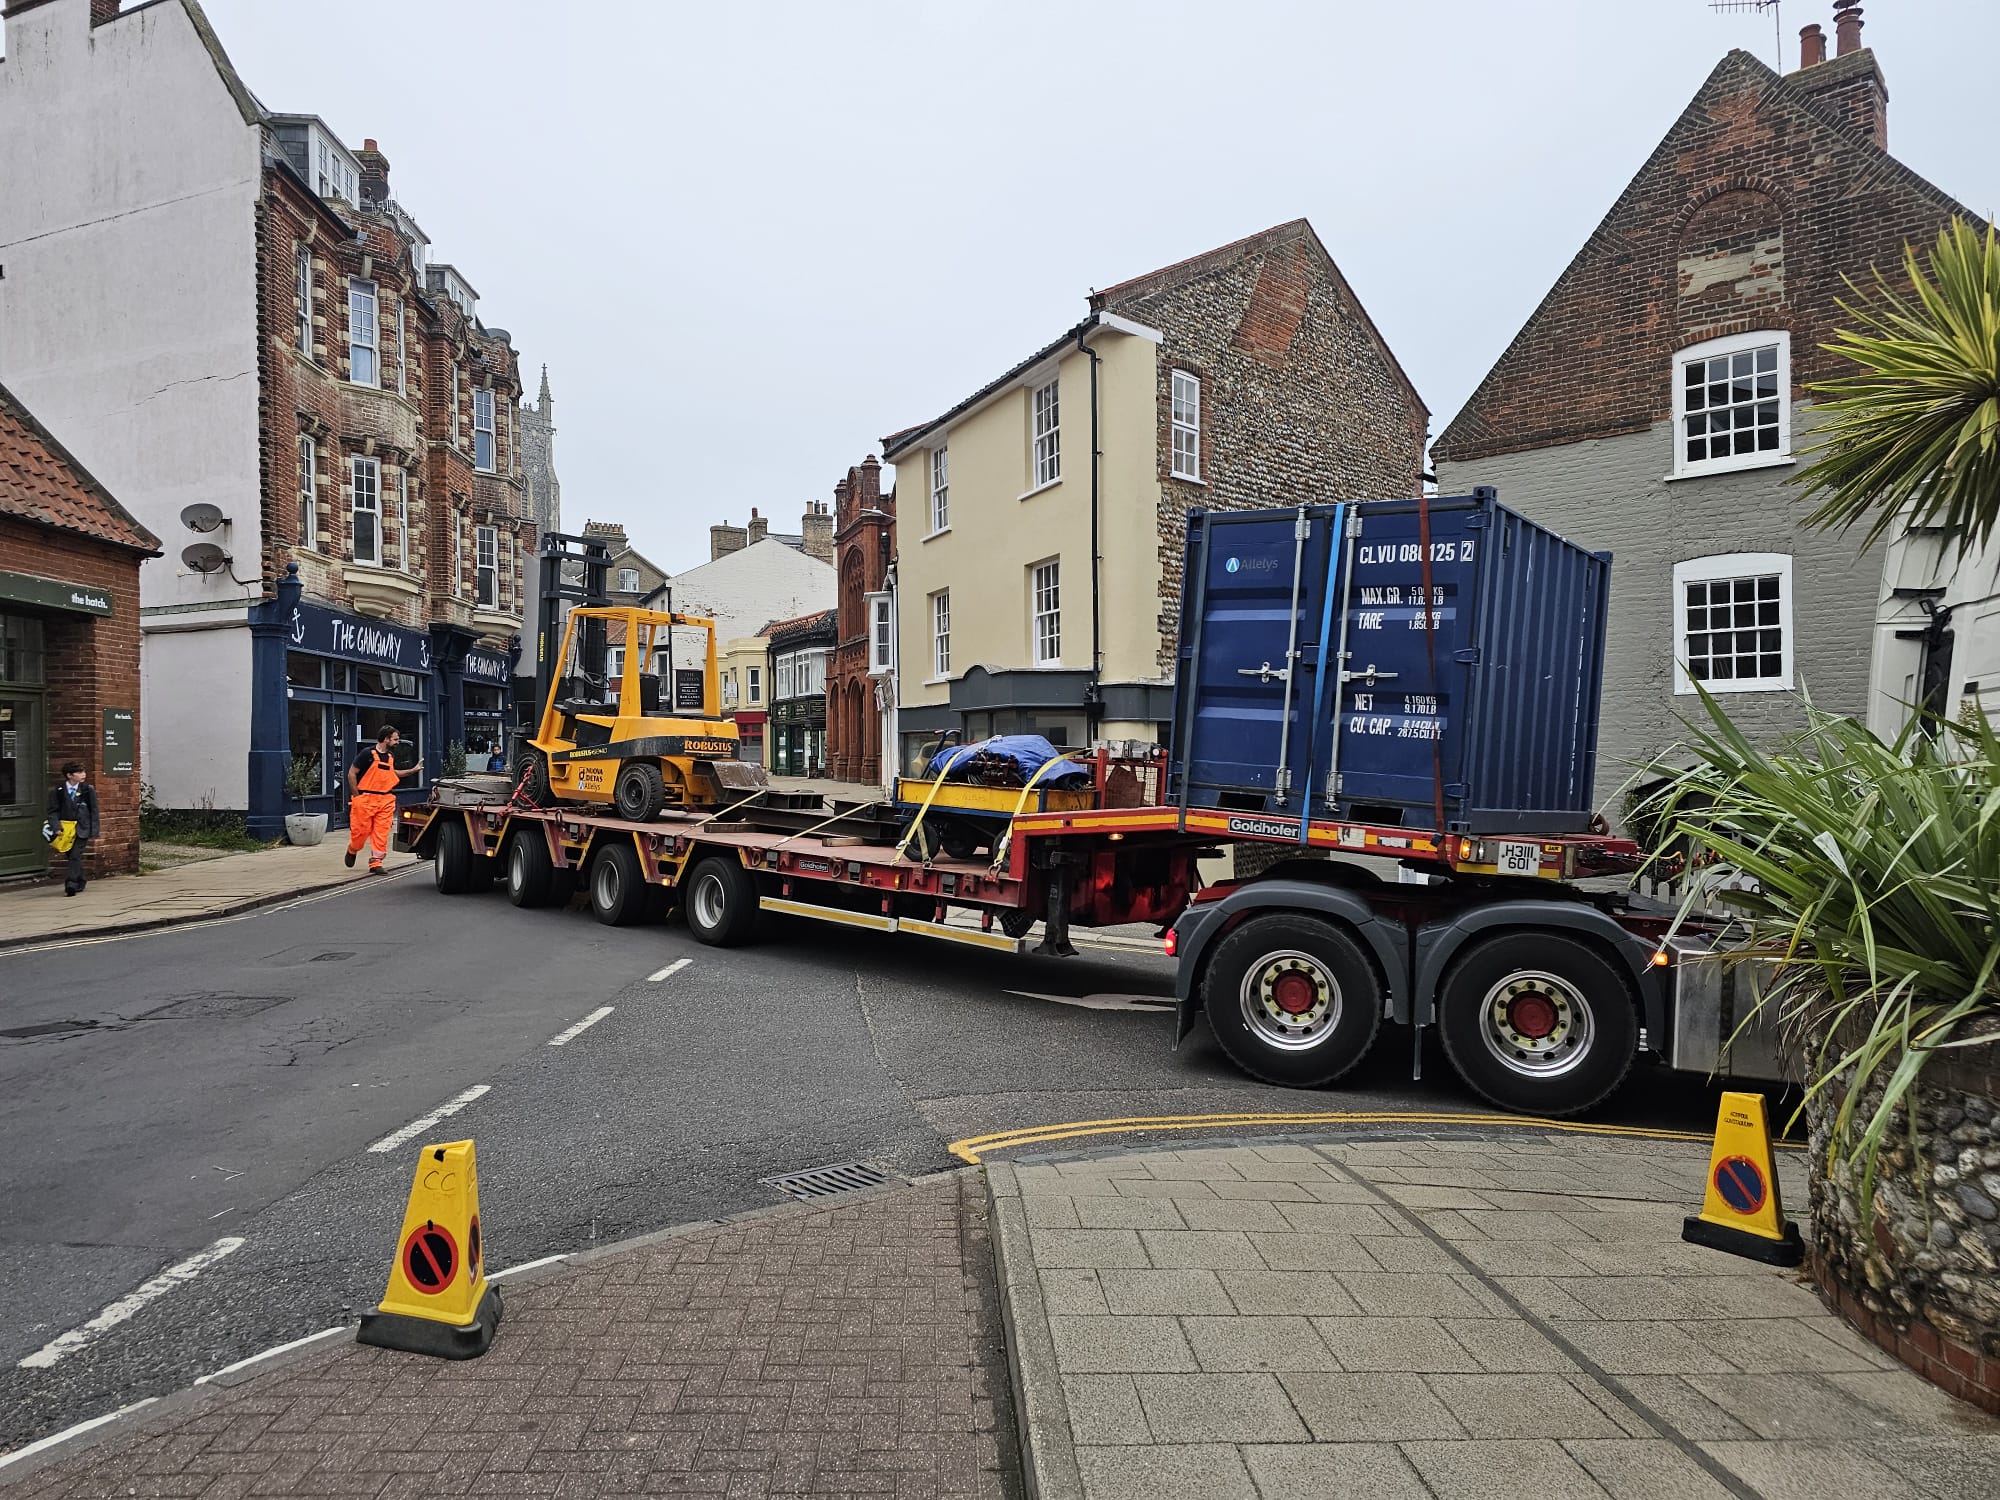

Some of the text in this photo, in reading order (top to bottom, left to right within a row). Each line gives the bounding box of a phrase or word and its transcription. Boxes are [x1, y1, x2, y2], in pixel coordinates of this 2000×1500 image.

[1359, 545, 1396, 564] CLVU
[1461, 541, 1474, 561] 2
[1240, 558, 1279, 572] Allelys
[71, 592, 108, 609] the hatch.
[1358, 612, 1385, 630] TARE
[332, 619, 401, 664] THE GANGWAY
[465, 653, 477, 674] THE
[1354, 693, 1374, 711] NET
[1369, 717, 1392, 736] CAP.
[684, 739, 733, 752] ROBUSTUS
[1230, 819, 1299, 839] Goldhofer
[800, 861, 828, 871] Goldhofer
